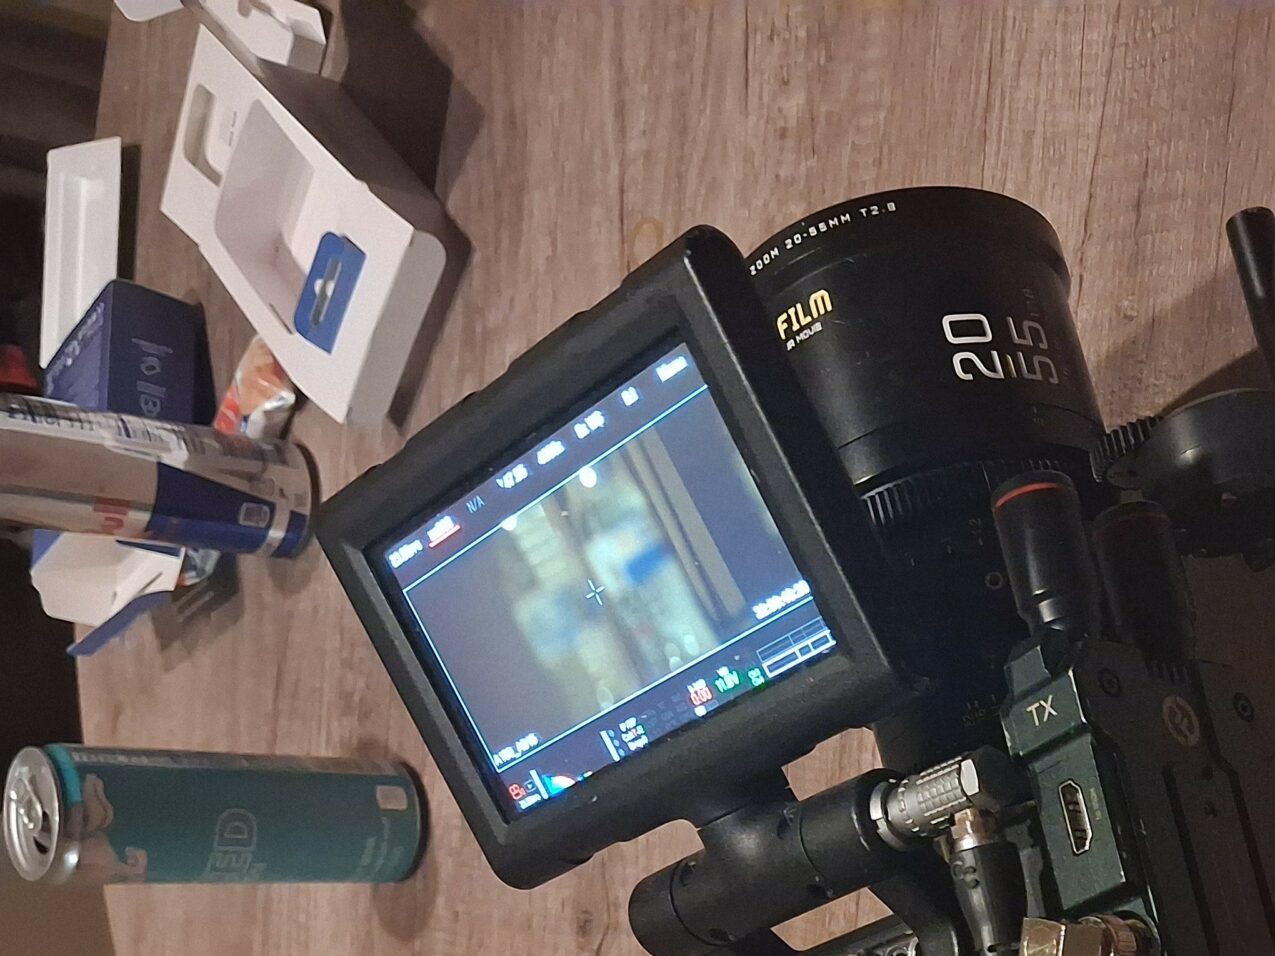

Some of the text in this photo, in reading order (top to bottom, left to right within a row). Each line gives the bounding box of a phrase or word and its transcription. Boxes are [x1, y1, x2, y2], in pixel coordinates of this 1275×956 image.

[749, 201, 896, 276] ZOOM 20-55MM T2.8
[776, 289, 833, 340] FILM
[941, 313, 1004, 380] 20
[466, 495, 485, 513] N/A
[1026, 694, 1058, 726] TX
